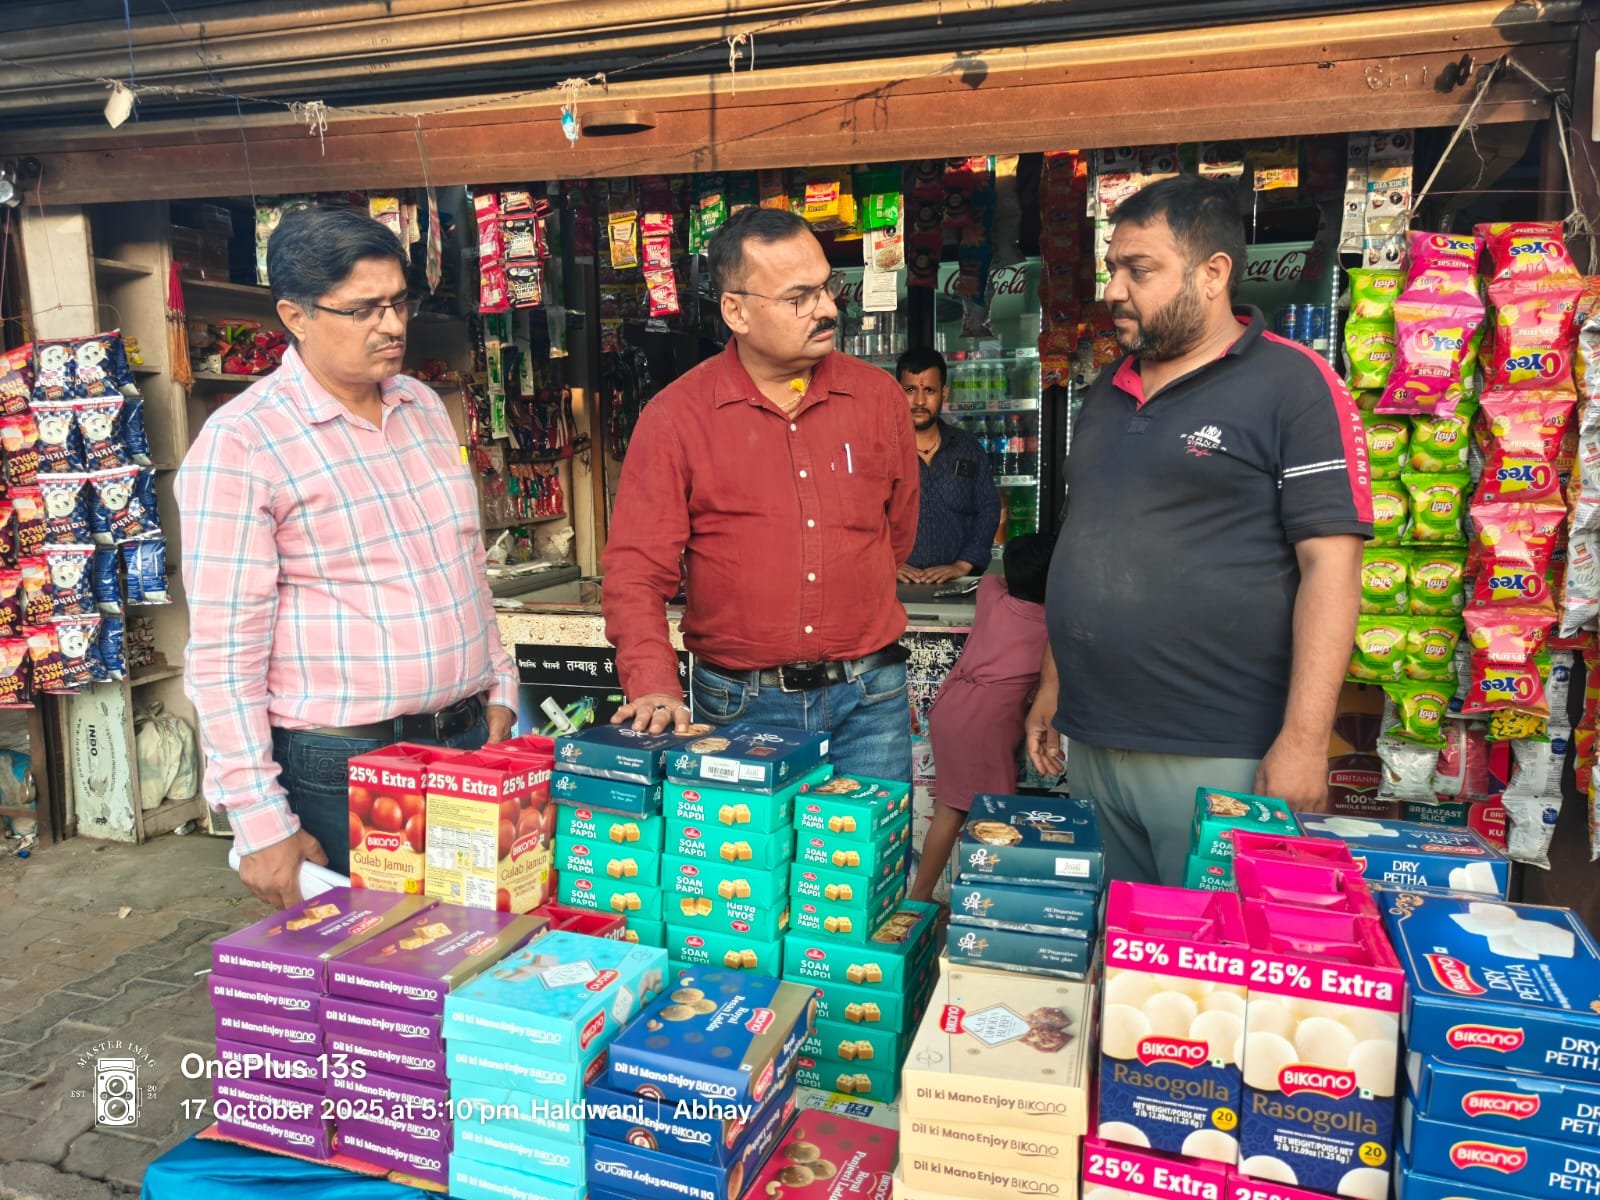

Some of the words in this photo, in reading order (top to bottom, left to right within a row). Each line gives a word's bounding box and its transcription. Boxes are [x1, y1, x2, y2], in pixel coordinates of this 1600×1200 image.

[350, 767, 377, 783] 25%
[382, 772, 416, 788] Extra
[428, 773, 458, 790] 25%
[462, 778, 497, 797] Extra
[502, 776, 525, 795] 25%
[528, 768, 550, 785] Extra
[1408, 806, 1462, 818] BREAKFAST
[354, 853, 381, 867] Gulab
[1393, 861, 1420, 872] DRY
[1384, 872, 1427, 886] PETHA
[800, 960, 830, 971] SOAN
[1112, 938, 1169, 965] 25%
[1178, 947, 1244, 976] Extra
[800, 968, 831, 979] PAPDI
[1251, 960, 1311, 989] 25%
[1321, 970, 1393, 1001] Extra
[1481, 967, 1507, 991] DRY
[1514, 964, 1544, 1001] PETHA
[1546, 1051, 1600, 1071] PETH
[614, 1062, 629, 1073] Dil
[629, 1065, 639, 1074] ki
[640, 1068, 667, 1082] Mano
[668, 1072, 695, 1090] Enjoy
[1113, 1063, 1230, 1101] Rasogolla
[917, 1088, 932, 1098] Dil
[935, 1090, 945, 1100] ki
[948, 1091, 982, 1104] Mano
[983, 1095, 1015, 1110] Enjoy
[1216, 1111, 1233, 1122] 20
[1252, 1094, 1378, 1133] Rasogolla
[912, 1123, 927, 1134] Dil
[930, 1125, 940, 1136] ki
[942, 1127, 975, 1142] Mano
[976, 1133, 1009, 1150] Enjoy
[1364, 1146, 1382, 1158] 20
[914, 1160, 928, 1172] Dil
[931, 1162, 941, 1174] ki
[944, 1164, 976, 1180] Mano
[978, 1170, 1009, 1187] Enjoy
[1089, 1154, 1144, 1185] 25%
[1152, 1168, 1218, 1200] Extra
